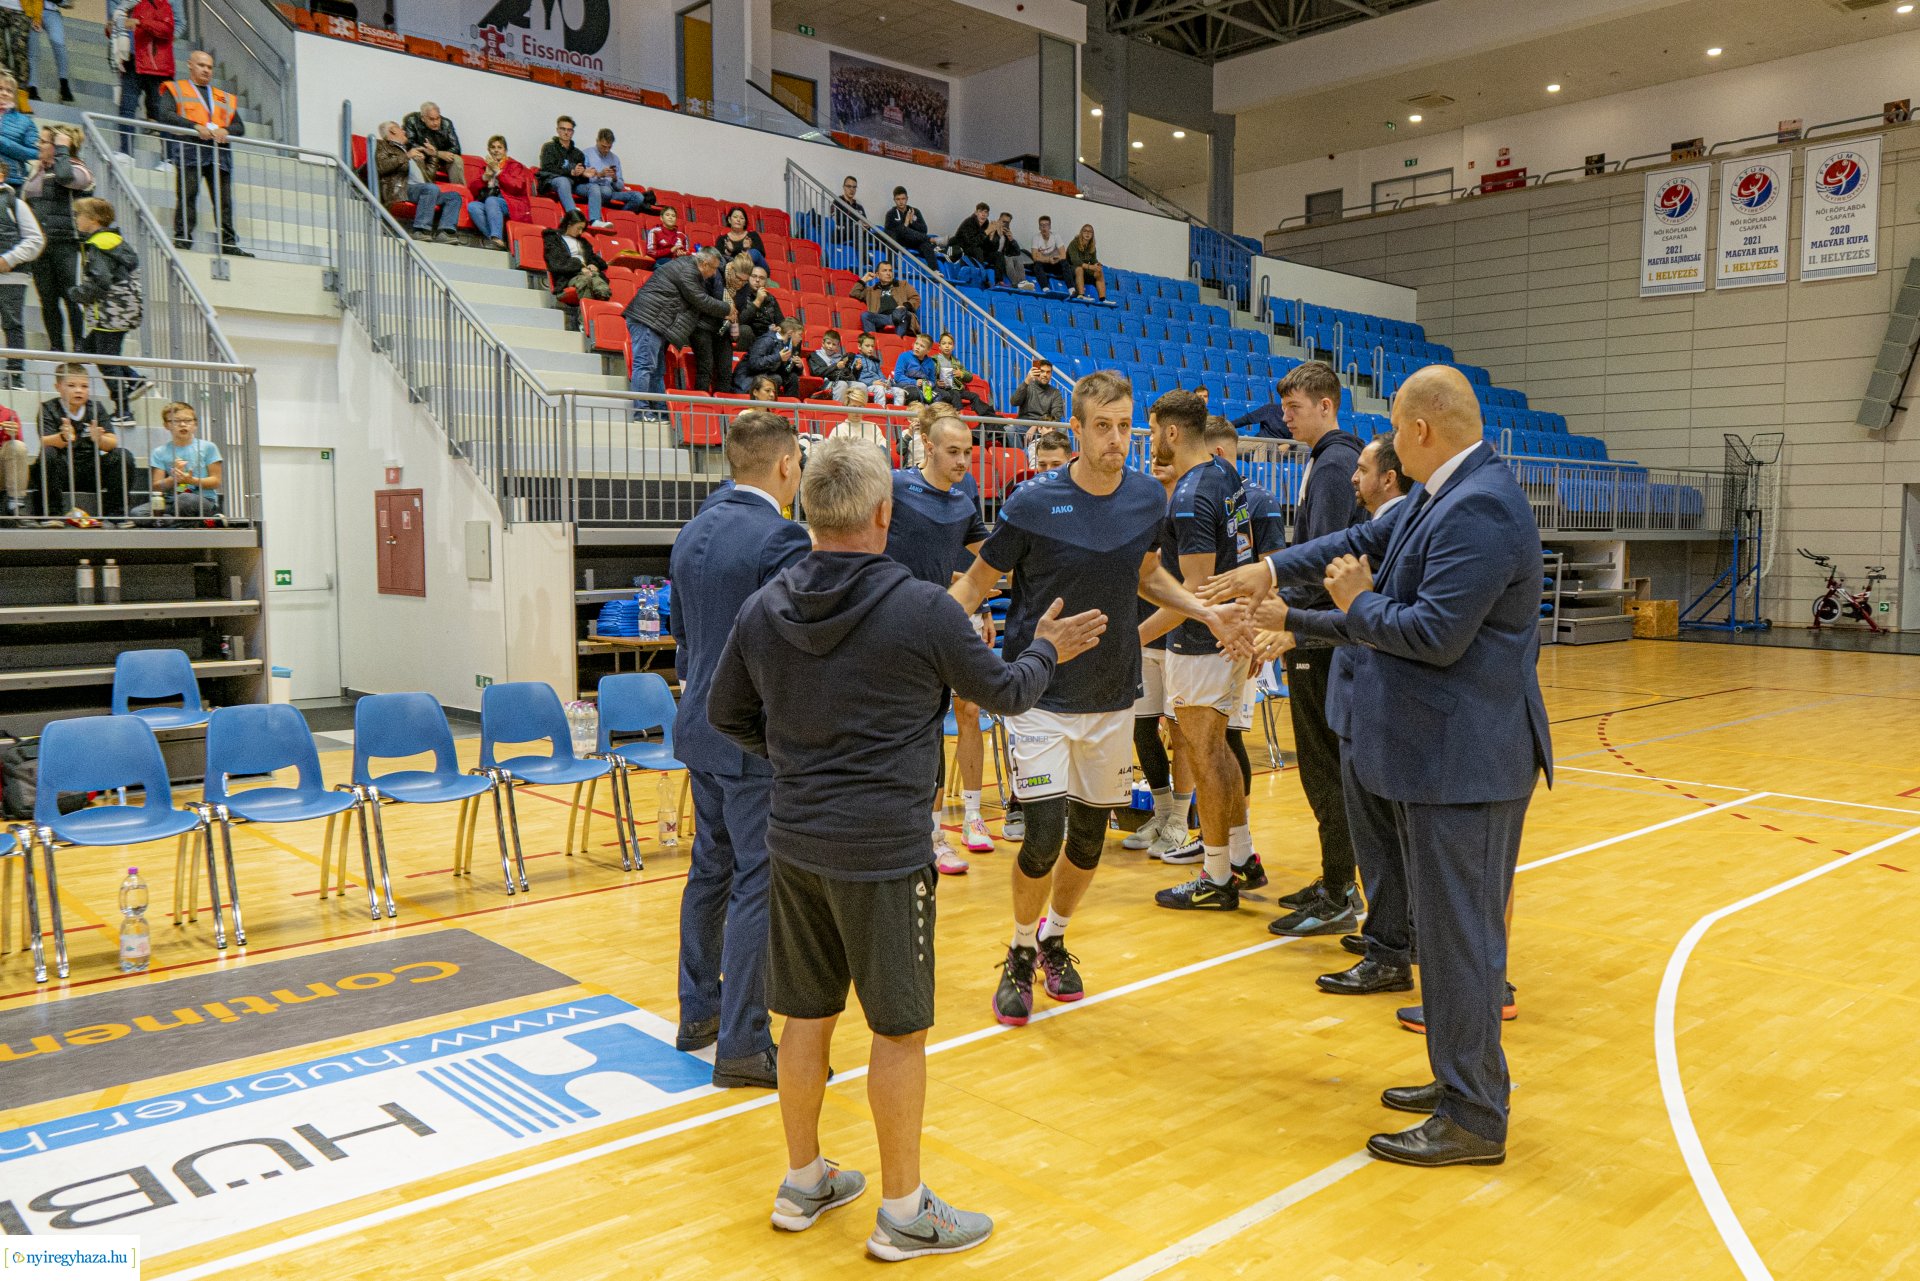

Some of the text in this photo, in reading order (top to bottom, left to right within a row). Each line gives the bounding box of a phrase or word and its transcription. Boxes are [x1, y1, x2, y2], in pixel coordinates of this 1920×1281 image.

[522, 34, 603, 72] Eissmann
[1820, 154, 1853, 175] FATUM
[1735, 167, 1766, 187] FATUM
[1657, 179, 1687, 198] FATUM
[1825, 213, 1856, 221] CSAPATA
[1739, 224, 1767, 232] CSAPATA
[1830, 225, 1850, 235] 2020
[1661, 233, 1688, 242] CSAPATA
[1743, 235, 1761, 245] 2021
[1810, 234, 1869, 249] MAGYAR KUPA
[1665, 245, 1683, 255] 2021
[1725, 245, 1779, 259] MAGYAR KUPA
[1808, 246, 1871, 265] II. HELYEZÉS
[1647, 256, 1670, 266] MAGYAR
[1724, 257, 1779, 273] I. HELYEZÉS
[1648, 266, 1699, 281] I. HELYEZÉS
[908, 484, 923, 493] JAKO
[1051, 504, 1074, 515] JAKO
[0, 960, 461, 1062] Continen
